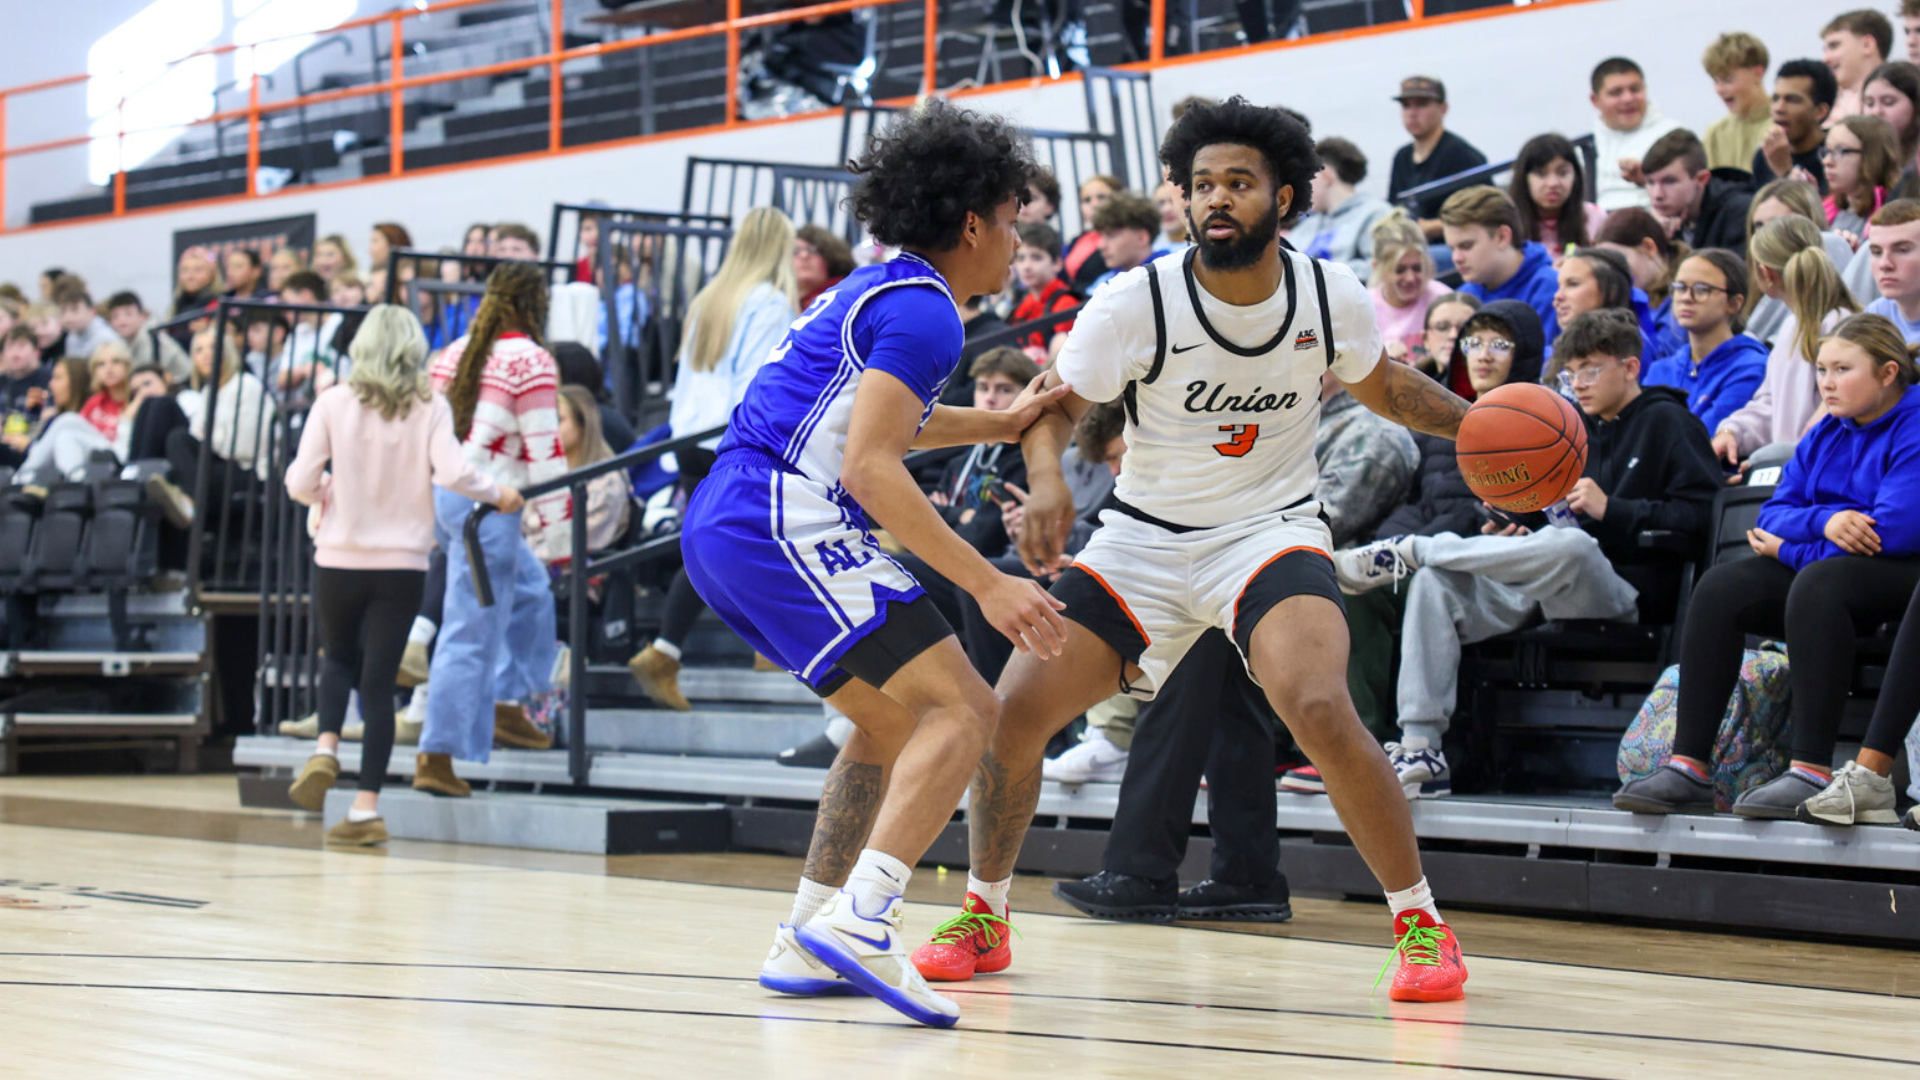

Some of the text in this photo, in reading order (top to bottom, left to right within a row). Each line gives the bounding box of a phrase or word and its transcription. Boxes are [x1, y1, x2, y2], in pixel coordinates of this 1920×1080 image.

[1184, 379, 1302, 413] Union
[1212, 423, 1260, 458] 3
[1462, 462, 1531, 486] ALDING
[814, 538, 874, 577] AL
